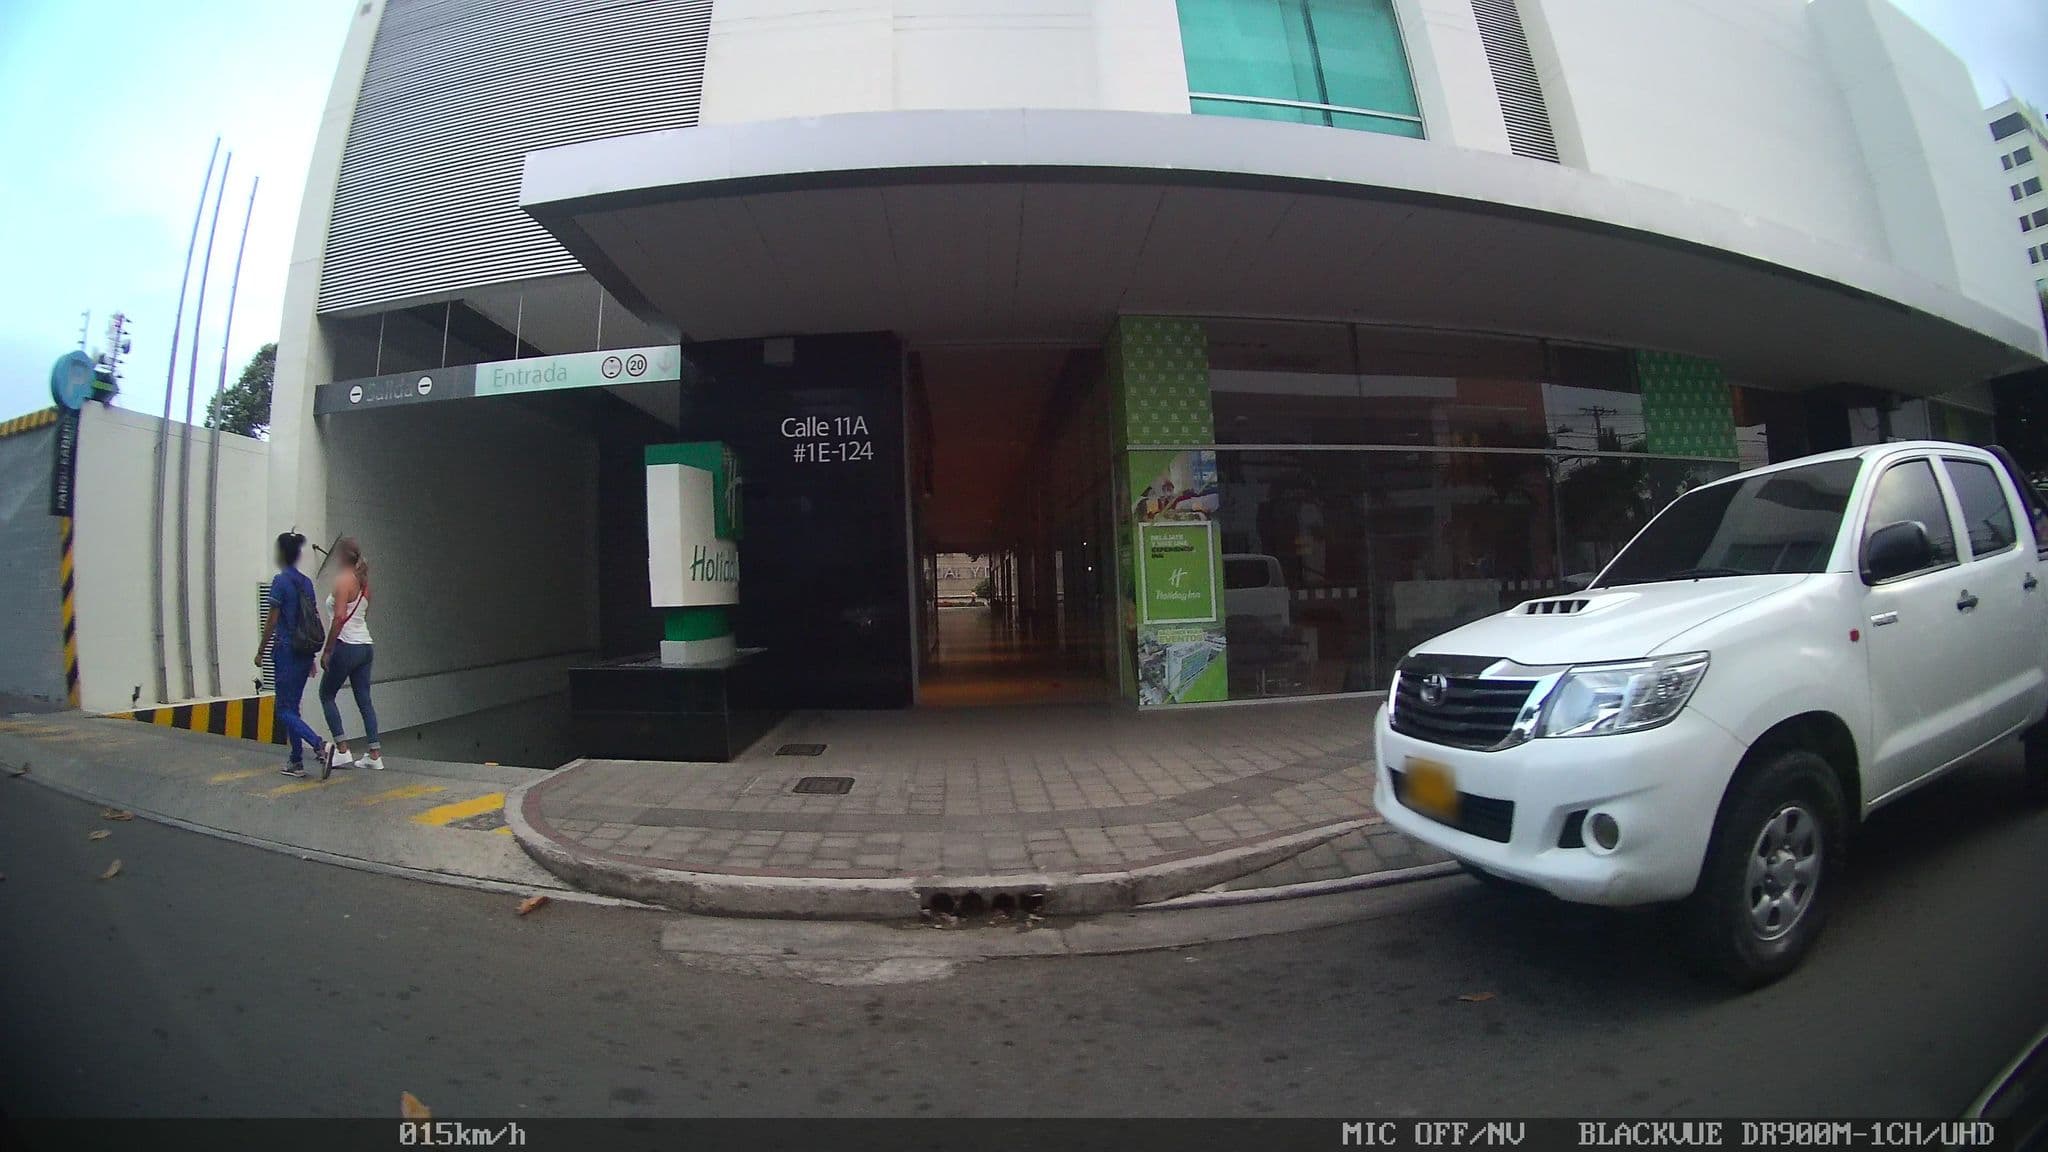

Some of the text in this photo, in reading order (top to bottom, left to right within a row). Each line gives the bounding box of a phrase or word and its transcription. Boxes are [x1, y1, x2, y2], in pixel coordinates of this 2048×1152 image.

[493, 361, 568, 388] Entrada
[630, 359, 644, 371] 20
[781, 415, 869, 438] Calle 11A
[793, 440, 874, 463] #1E-124
[1155, 589, 1201, 601] Holiday Inn
